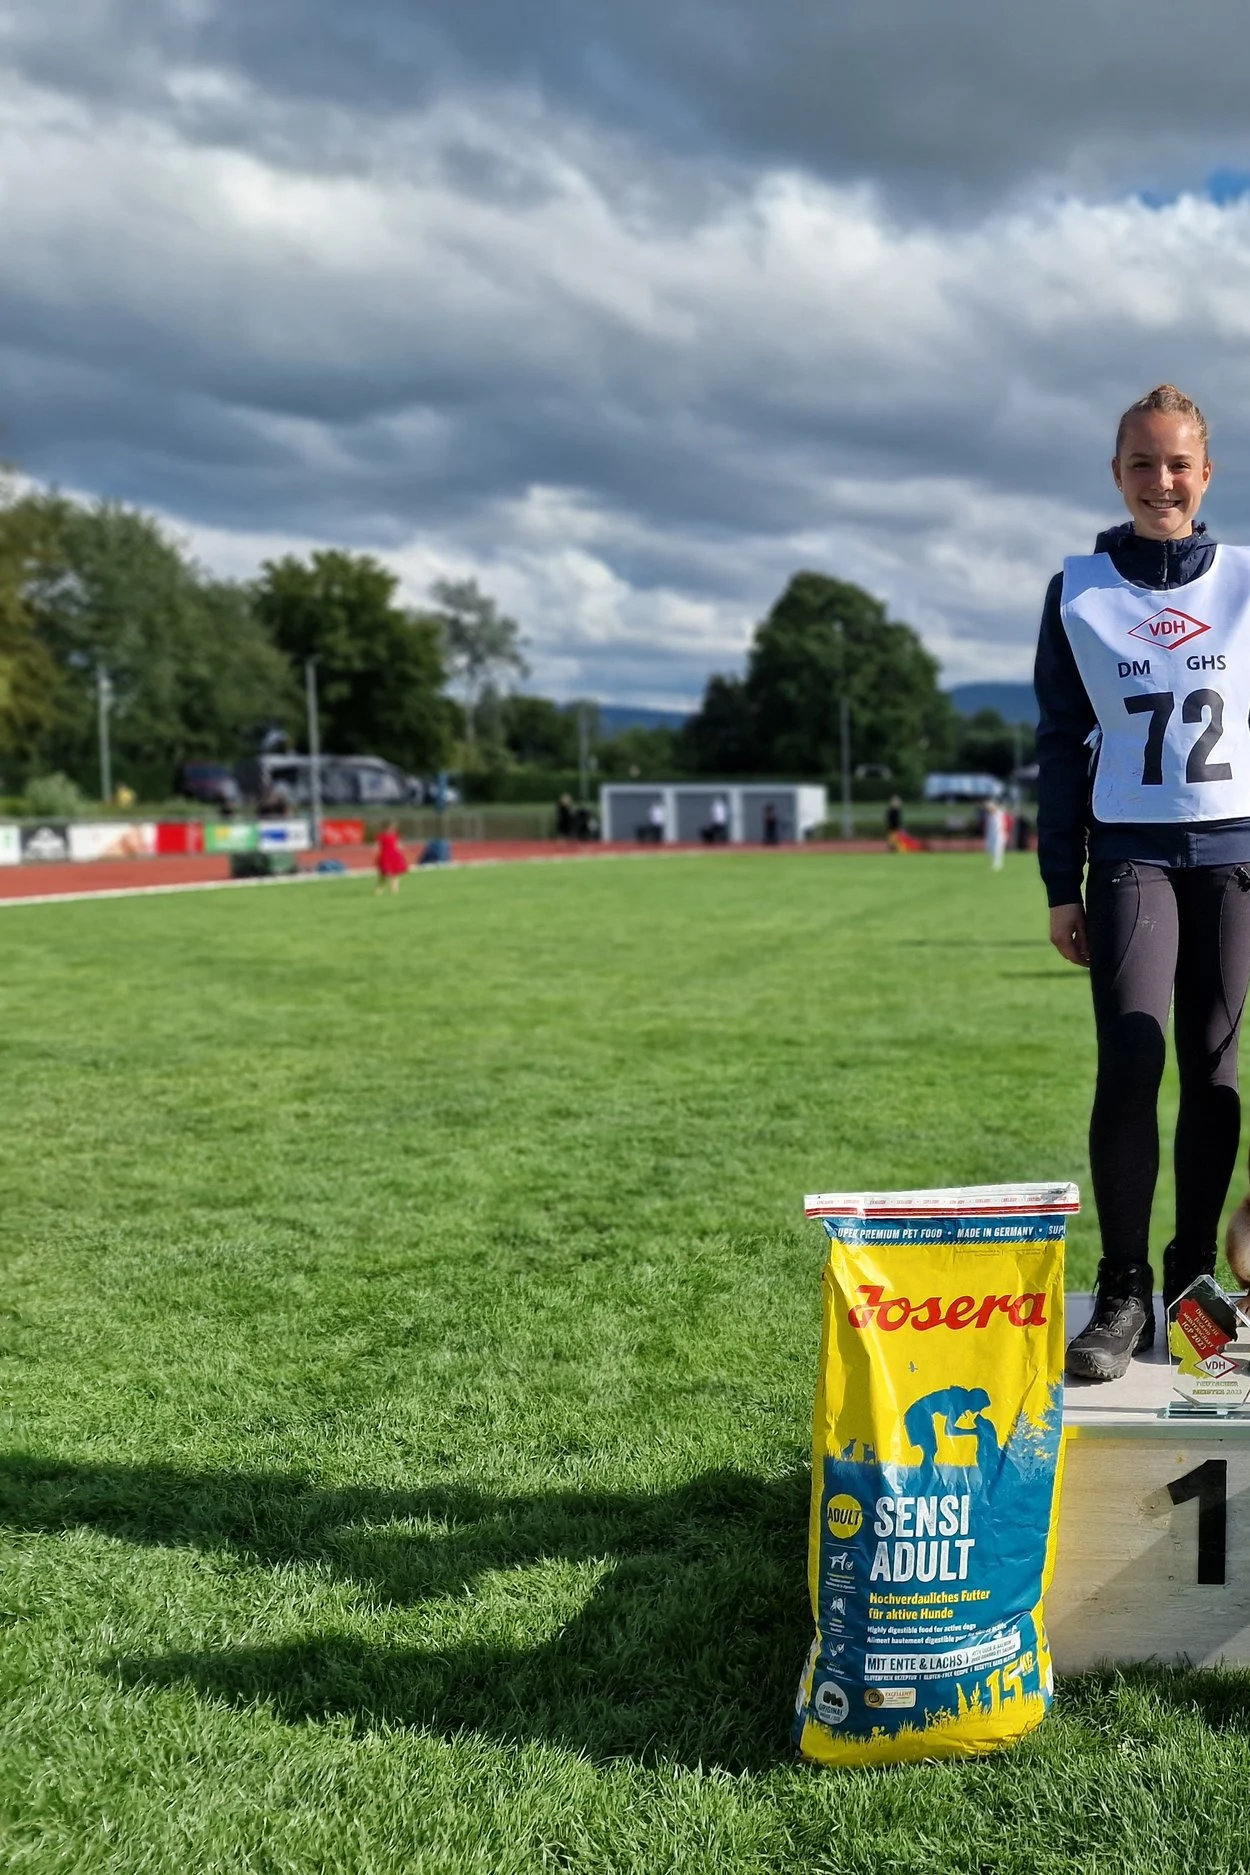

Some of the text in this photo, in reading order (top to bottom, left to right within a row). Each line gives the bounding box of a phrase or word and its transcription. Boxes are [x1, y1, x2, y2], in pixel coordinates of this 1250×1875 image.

[1148, 620, 1186, 637] VDH
[1118, 655, 1227, 678] DM GHS
[1123, 688, 1233, 786] 72
[860, 1229, 899, 1239] PREMIUM
[902, 1229, 918, 1239] PET
[920, 1228, 943, 1238] FOOD
[957, 1228, 980, 1238] MADE
[982, 1227, 992, 1237] IN
[994, 1226, 1034, 1237] GERMANY
[847, 1284, 1047, 1332] Josera
[1182, 1321, 1194, 1334] IGP
[1205, 1361, 1226, 1371] VDH
[828, 1507, 862, 1526] ADULT
[874, 1494, 971, 1538] SENSI
[1166, 1459, 1228, 1585] 1
[869, 1539, 975, 1582] ADULT
[869, 1589, 991, 1606] Hochverdauliches Futter
[868, 1607, 954, 1620] für aktive Hunde
[867, 1626, 887, 1635] Highly
[887, 1624, 918, 1636] digestible
[918, 1625, 933, 1634] food
[933, 1624, 943, 1634] for
[944, 1623, 962, 1633] active
[962, 1622, 977, 1632] dogs
[867, 1635, 890, 1644] Aliment
[891, 1636, 924, 1645] hautement
[925, 1634, 955, 1646] digestible
[867, 1653, 963, 1672] MIT ENTE & LACHS
[986, 1659, 1023, 1712] 15
